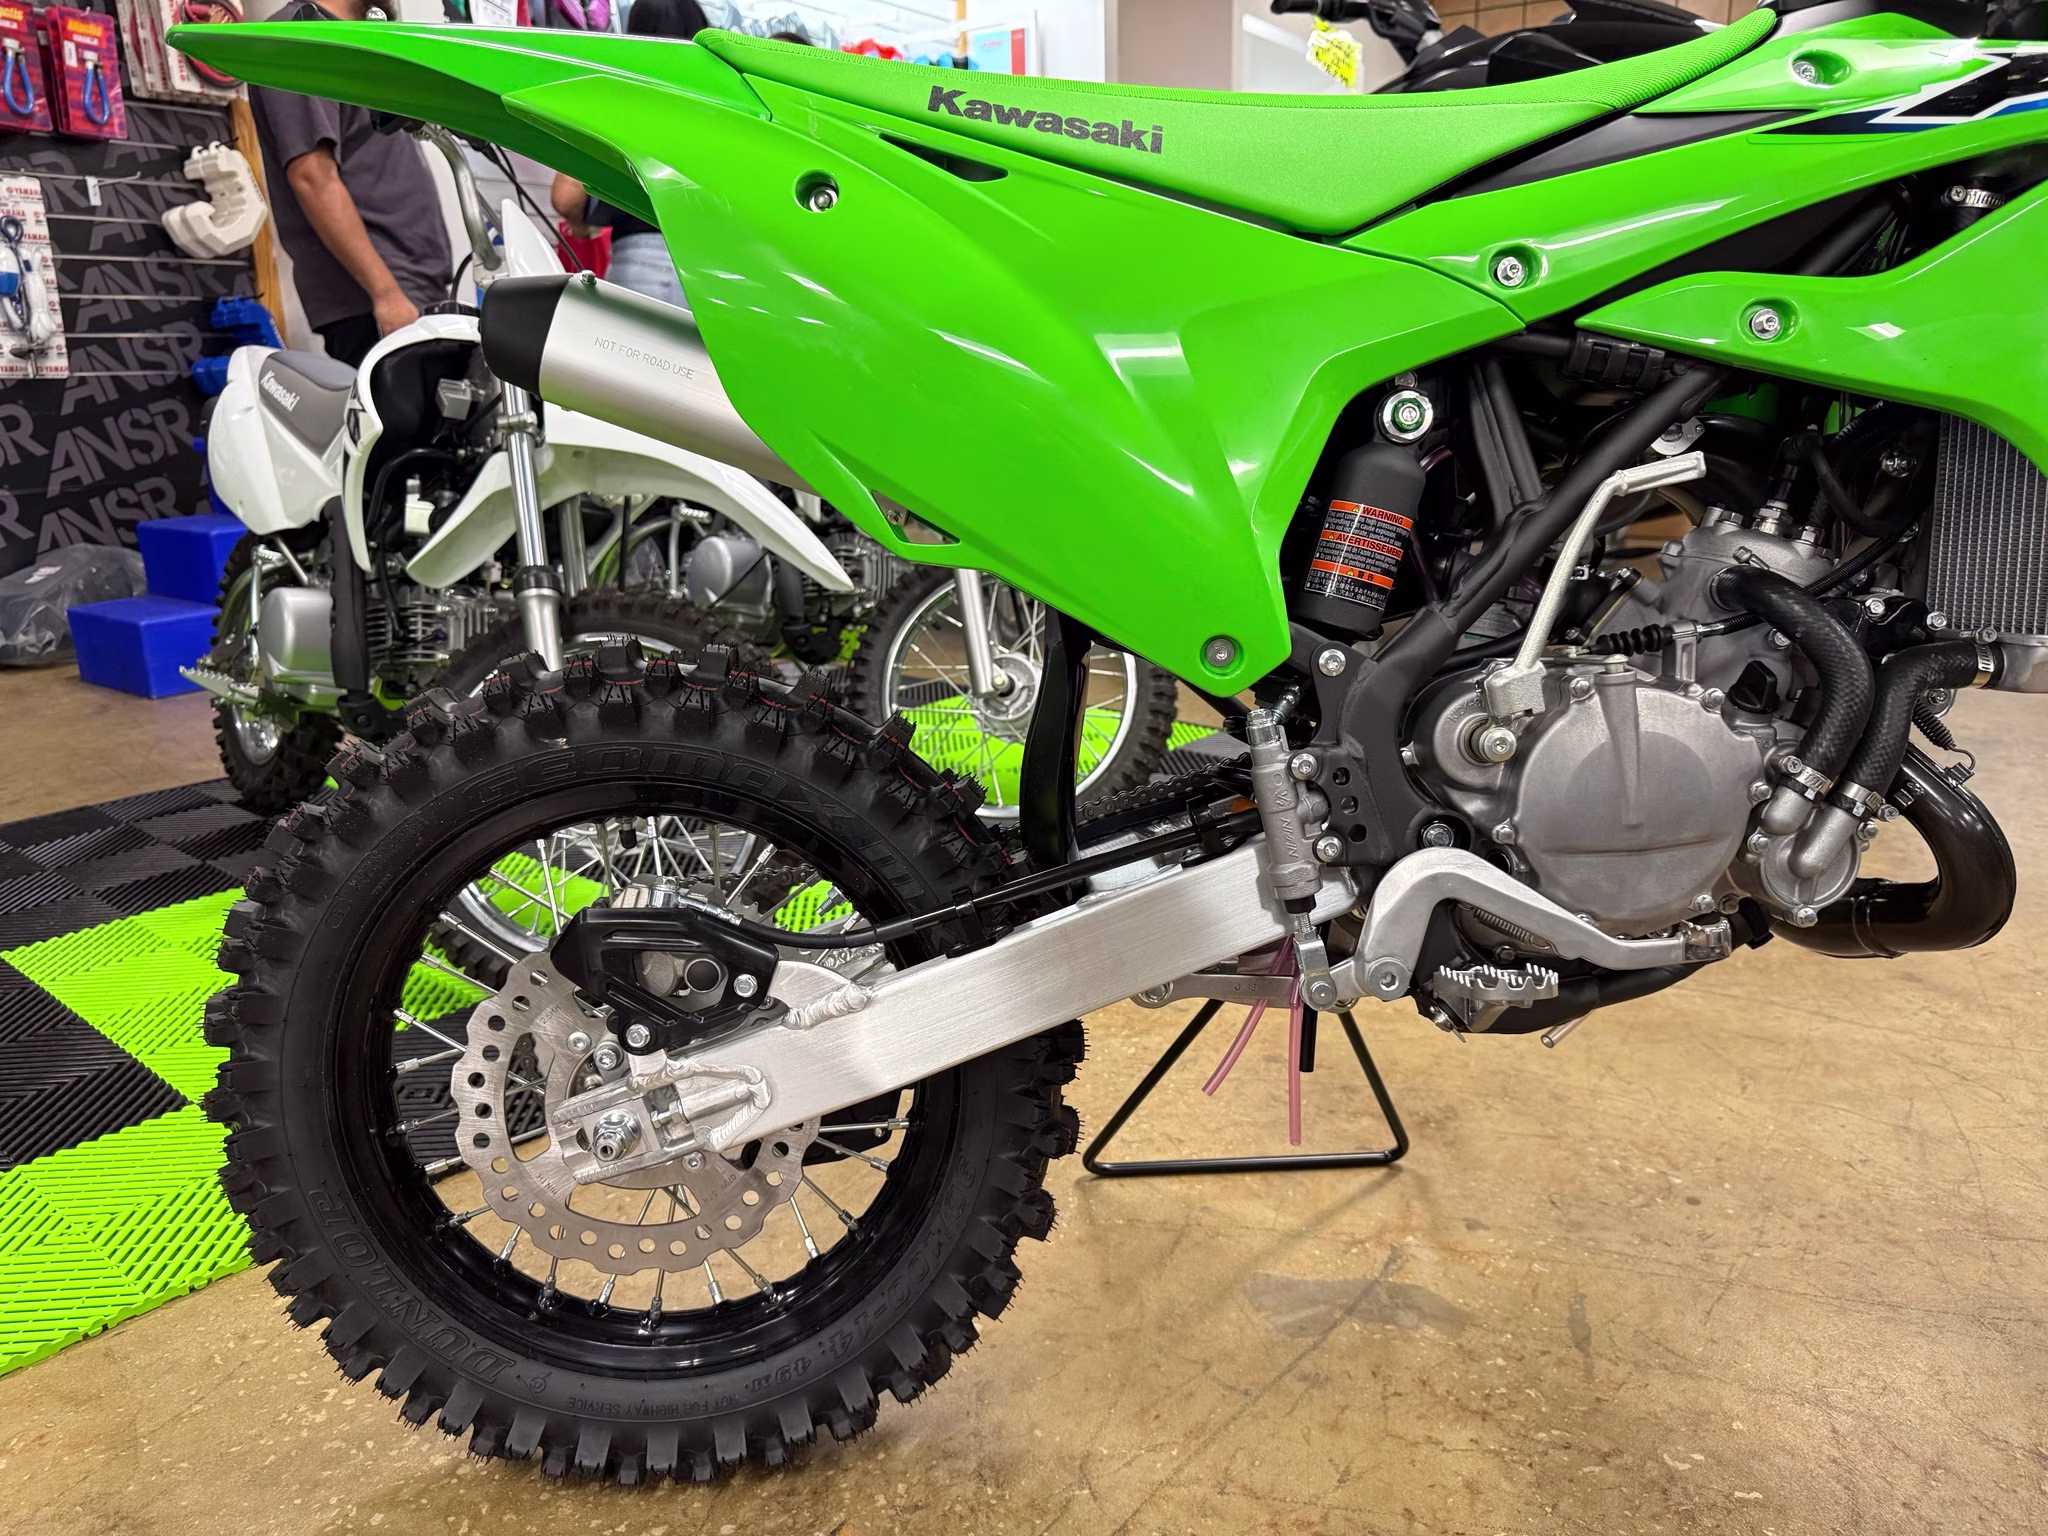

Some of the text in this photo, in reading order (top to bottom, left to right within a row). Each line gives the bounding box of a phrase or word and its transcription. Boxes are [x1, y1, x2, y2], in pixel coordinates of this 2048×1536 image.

[927, 85, 1164, 154] Kawasaki
[60, 320, 204, 416] ANSR
[594, 336, 695, 380] NOT FOR ROAD USE
[260, 370, 300, 412] Kawasaki
[46, 398, 196, 499] ANSR
[36, 476, 183, 562] ANSR
[1344, 512, 1365, 523] contns
[1365, 517, 1376, 526] high
[1376, 521, 1396, 532] pressure
[1359, 523, 1375, 532] cause
[1362, 506, 1404, 524] WARNING
[1335, 535, 1402, 560] AVERTISSEMENT
[1368, 532, 1389, 544] puncture
[308, 1190, 516, 1384] DUNLOP
[568, 1396, 620, 1416] SERVICE
[626, 1403, 680, 1416] HIGHWAY
[684, 1401, 710, 1414] FOR
